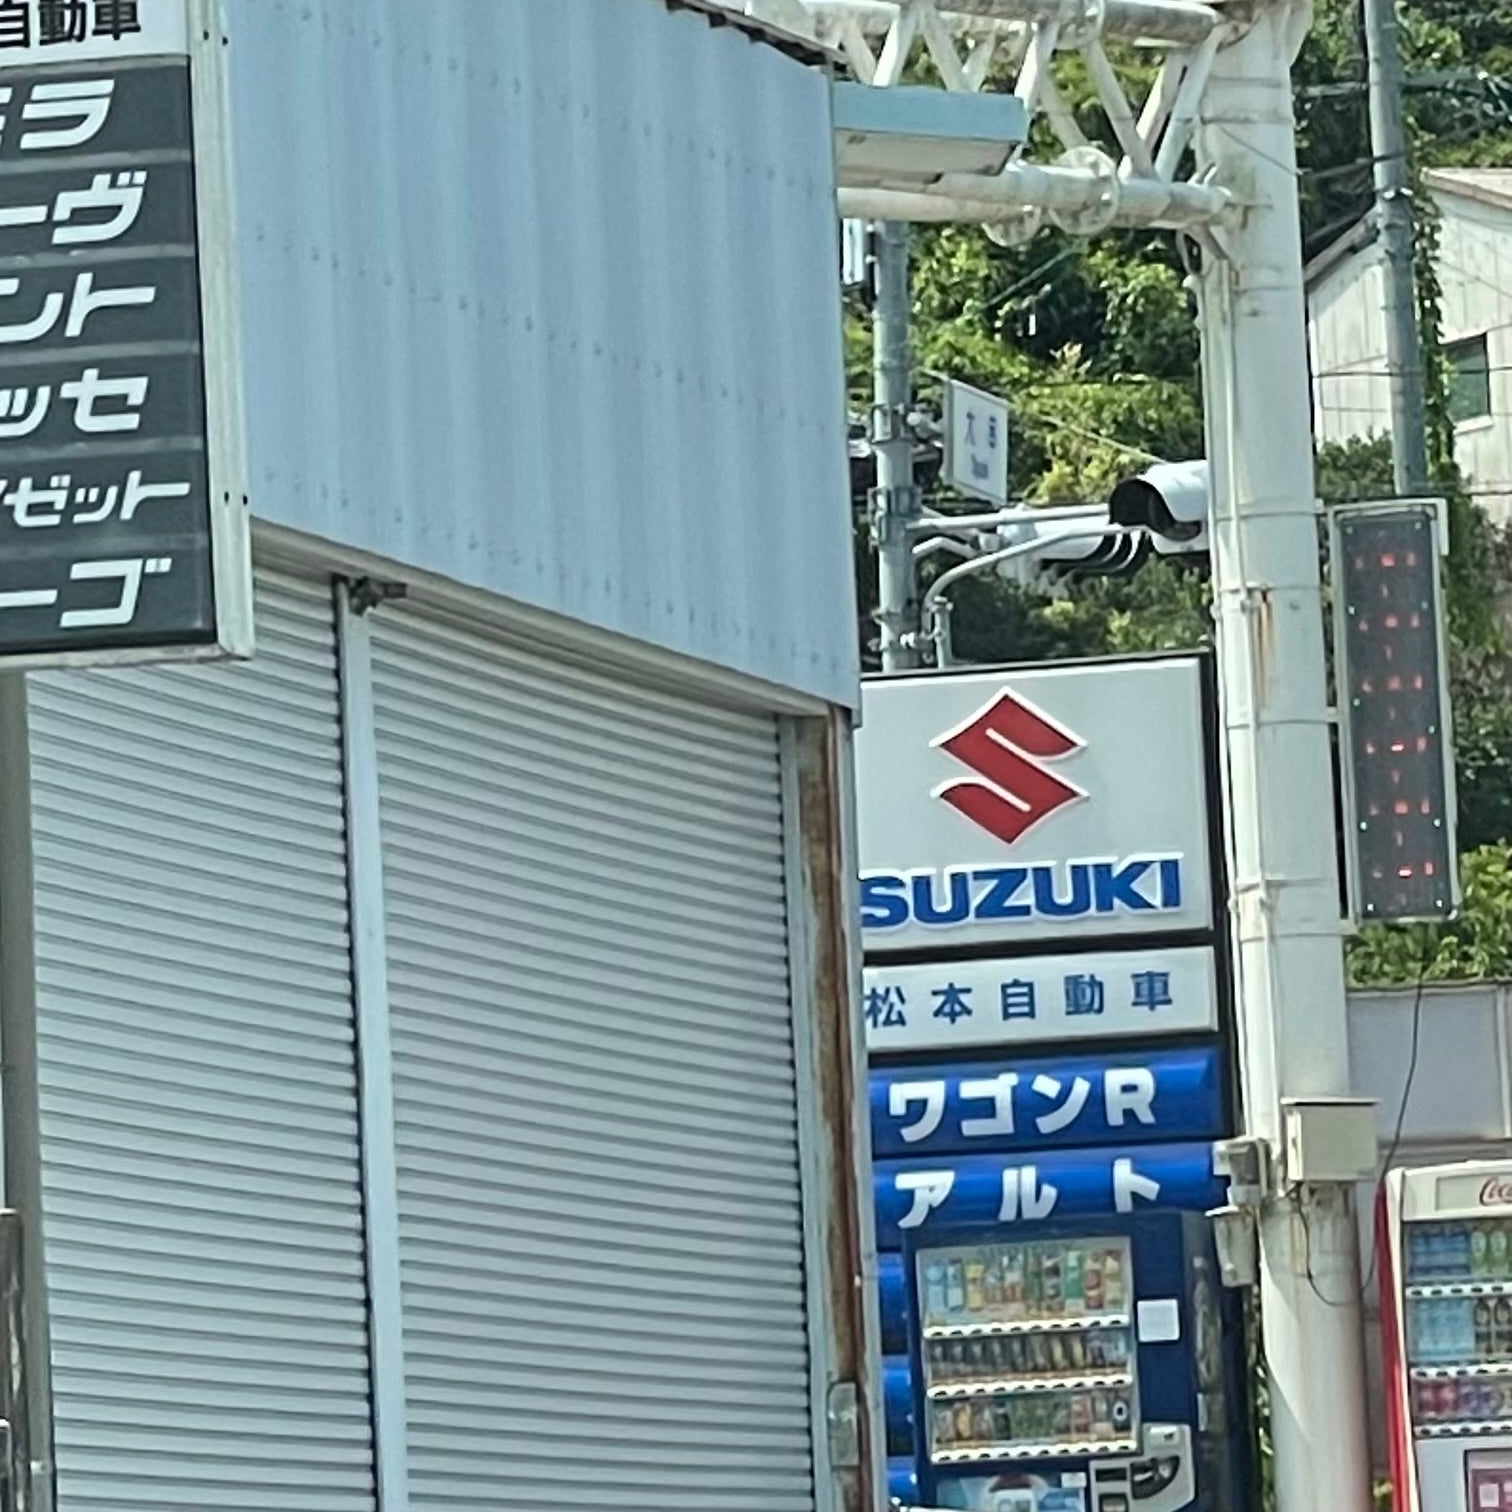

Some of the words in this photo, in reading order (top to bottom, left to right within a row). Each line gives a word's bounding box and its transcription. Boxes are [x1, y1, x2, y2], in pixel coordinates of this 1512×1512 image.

[859, 852, 1185, 929] SUZUKI
[865, 970, 1173, 1029] 松本自動車
[889, 1067, 1156, 1142] ワゴンR
[895, 1158, 1161, 1228] アルト
